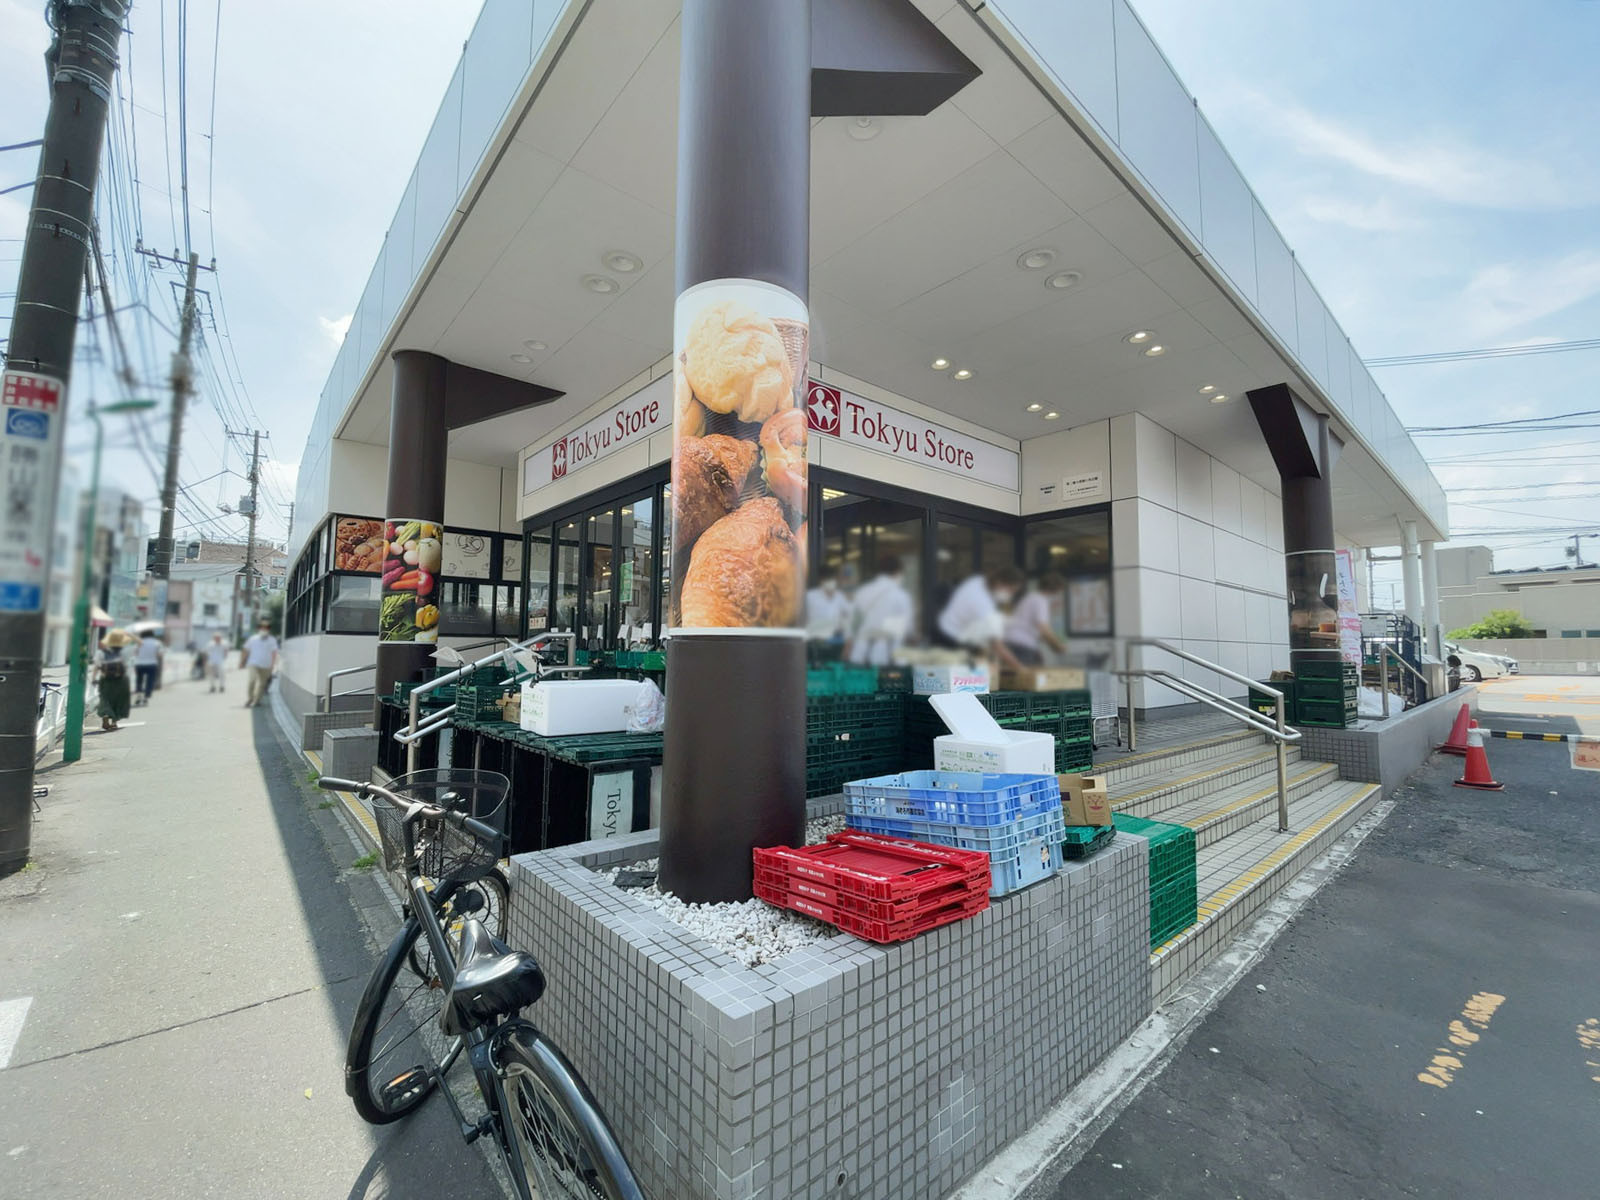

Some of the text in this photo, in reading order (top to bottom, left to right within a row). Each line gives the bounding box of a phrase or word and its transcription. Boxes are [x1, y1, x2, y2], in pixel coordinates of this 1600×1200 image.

[569, 400, 659, 465] Tokyu Store
[846, 401, 975, 470] Tokyu Store
